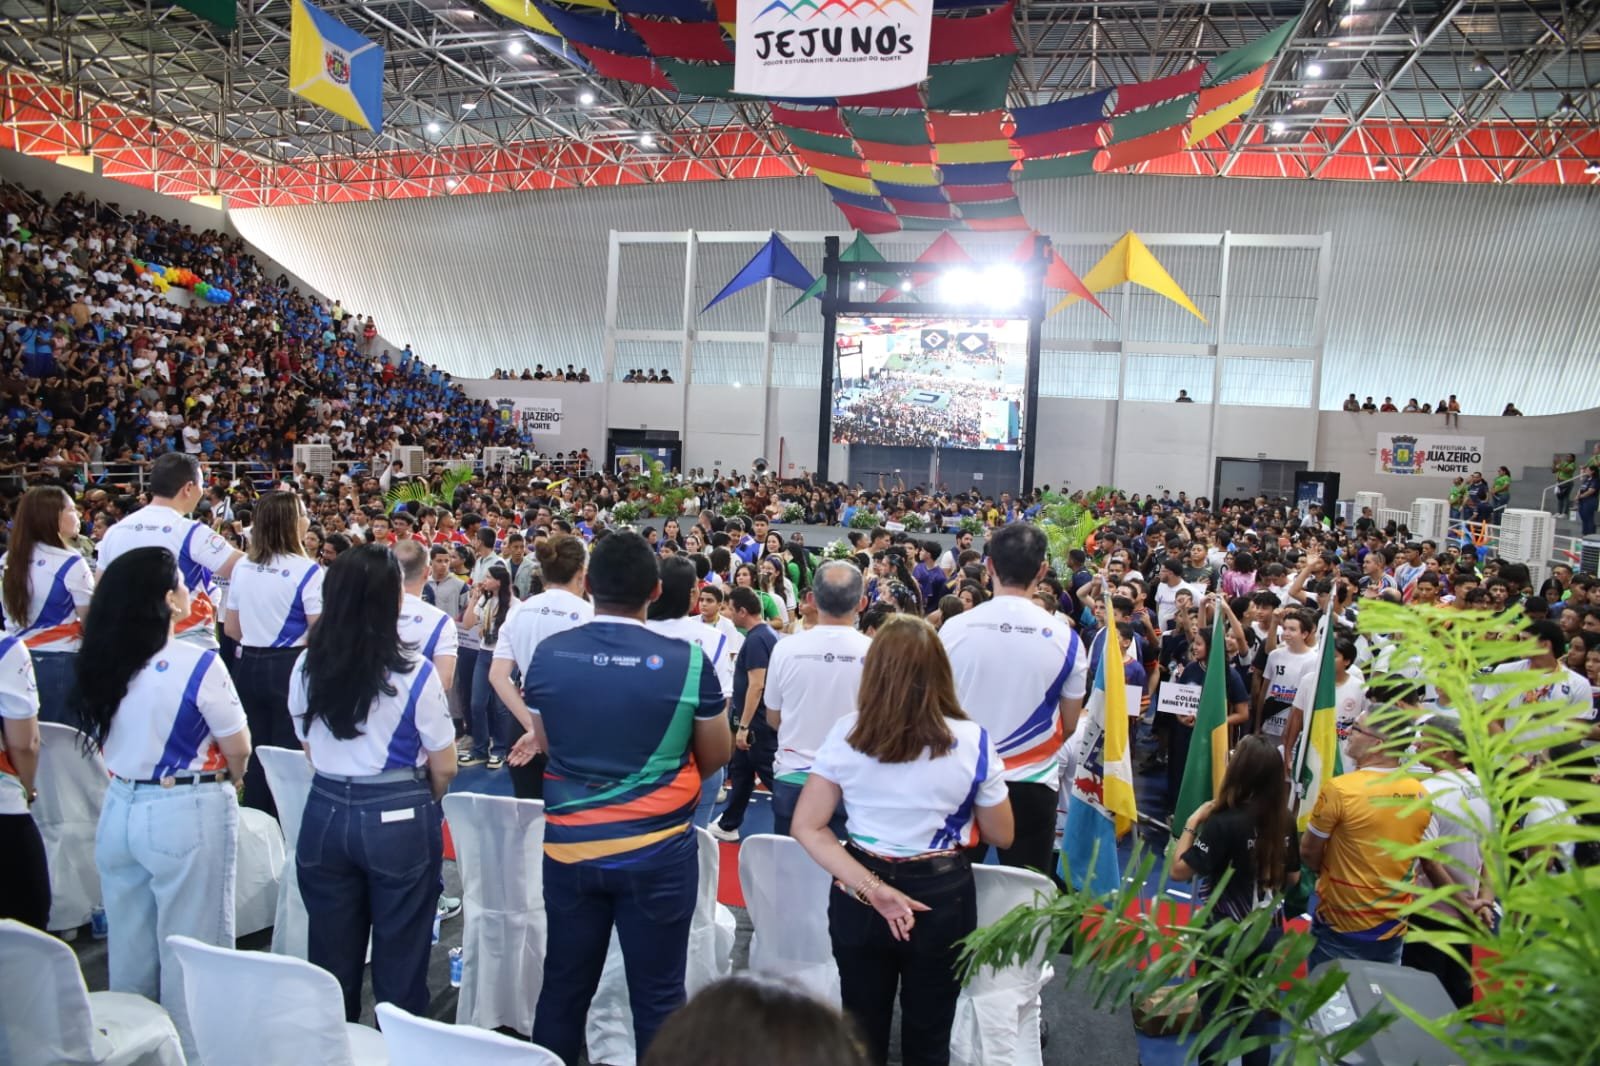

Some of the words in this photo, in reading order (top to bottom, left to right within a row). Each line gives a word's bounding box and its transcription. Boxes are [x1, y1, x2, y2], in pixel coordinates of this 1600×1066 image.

[521, 412, 560, 422] JUAZEIRO
[1425, 451, 1482, 463] JUAZEIRO
[1438, 464, 1469, 472] NORTE
[1276, 665, 1286, 676] 13
